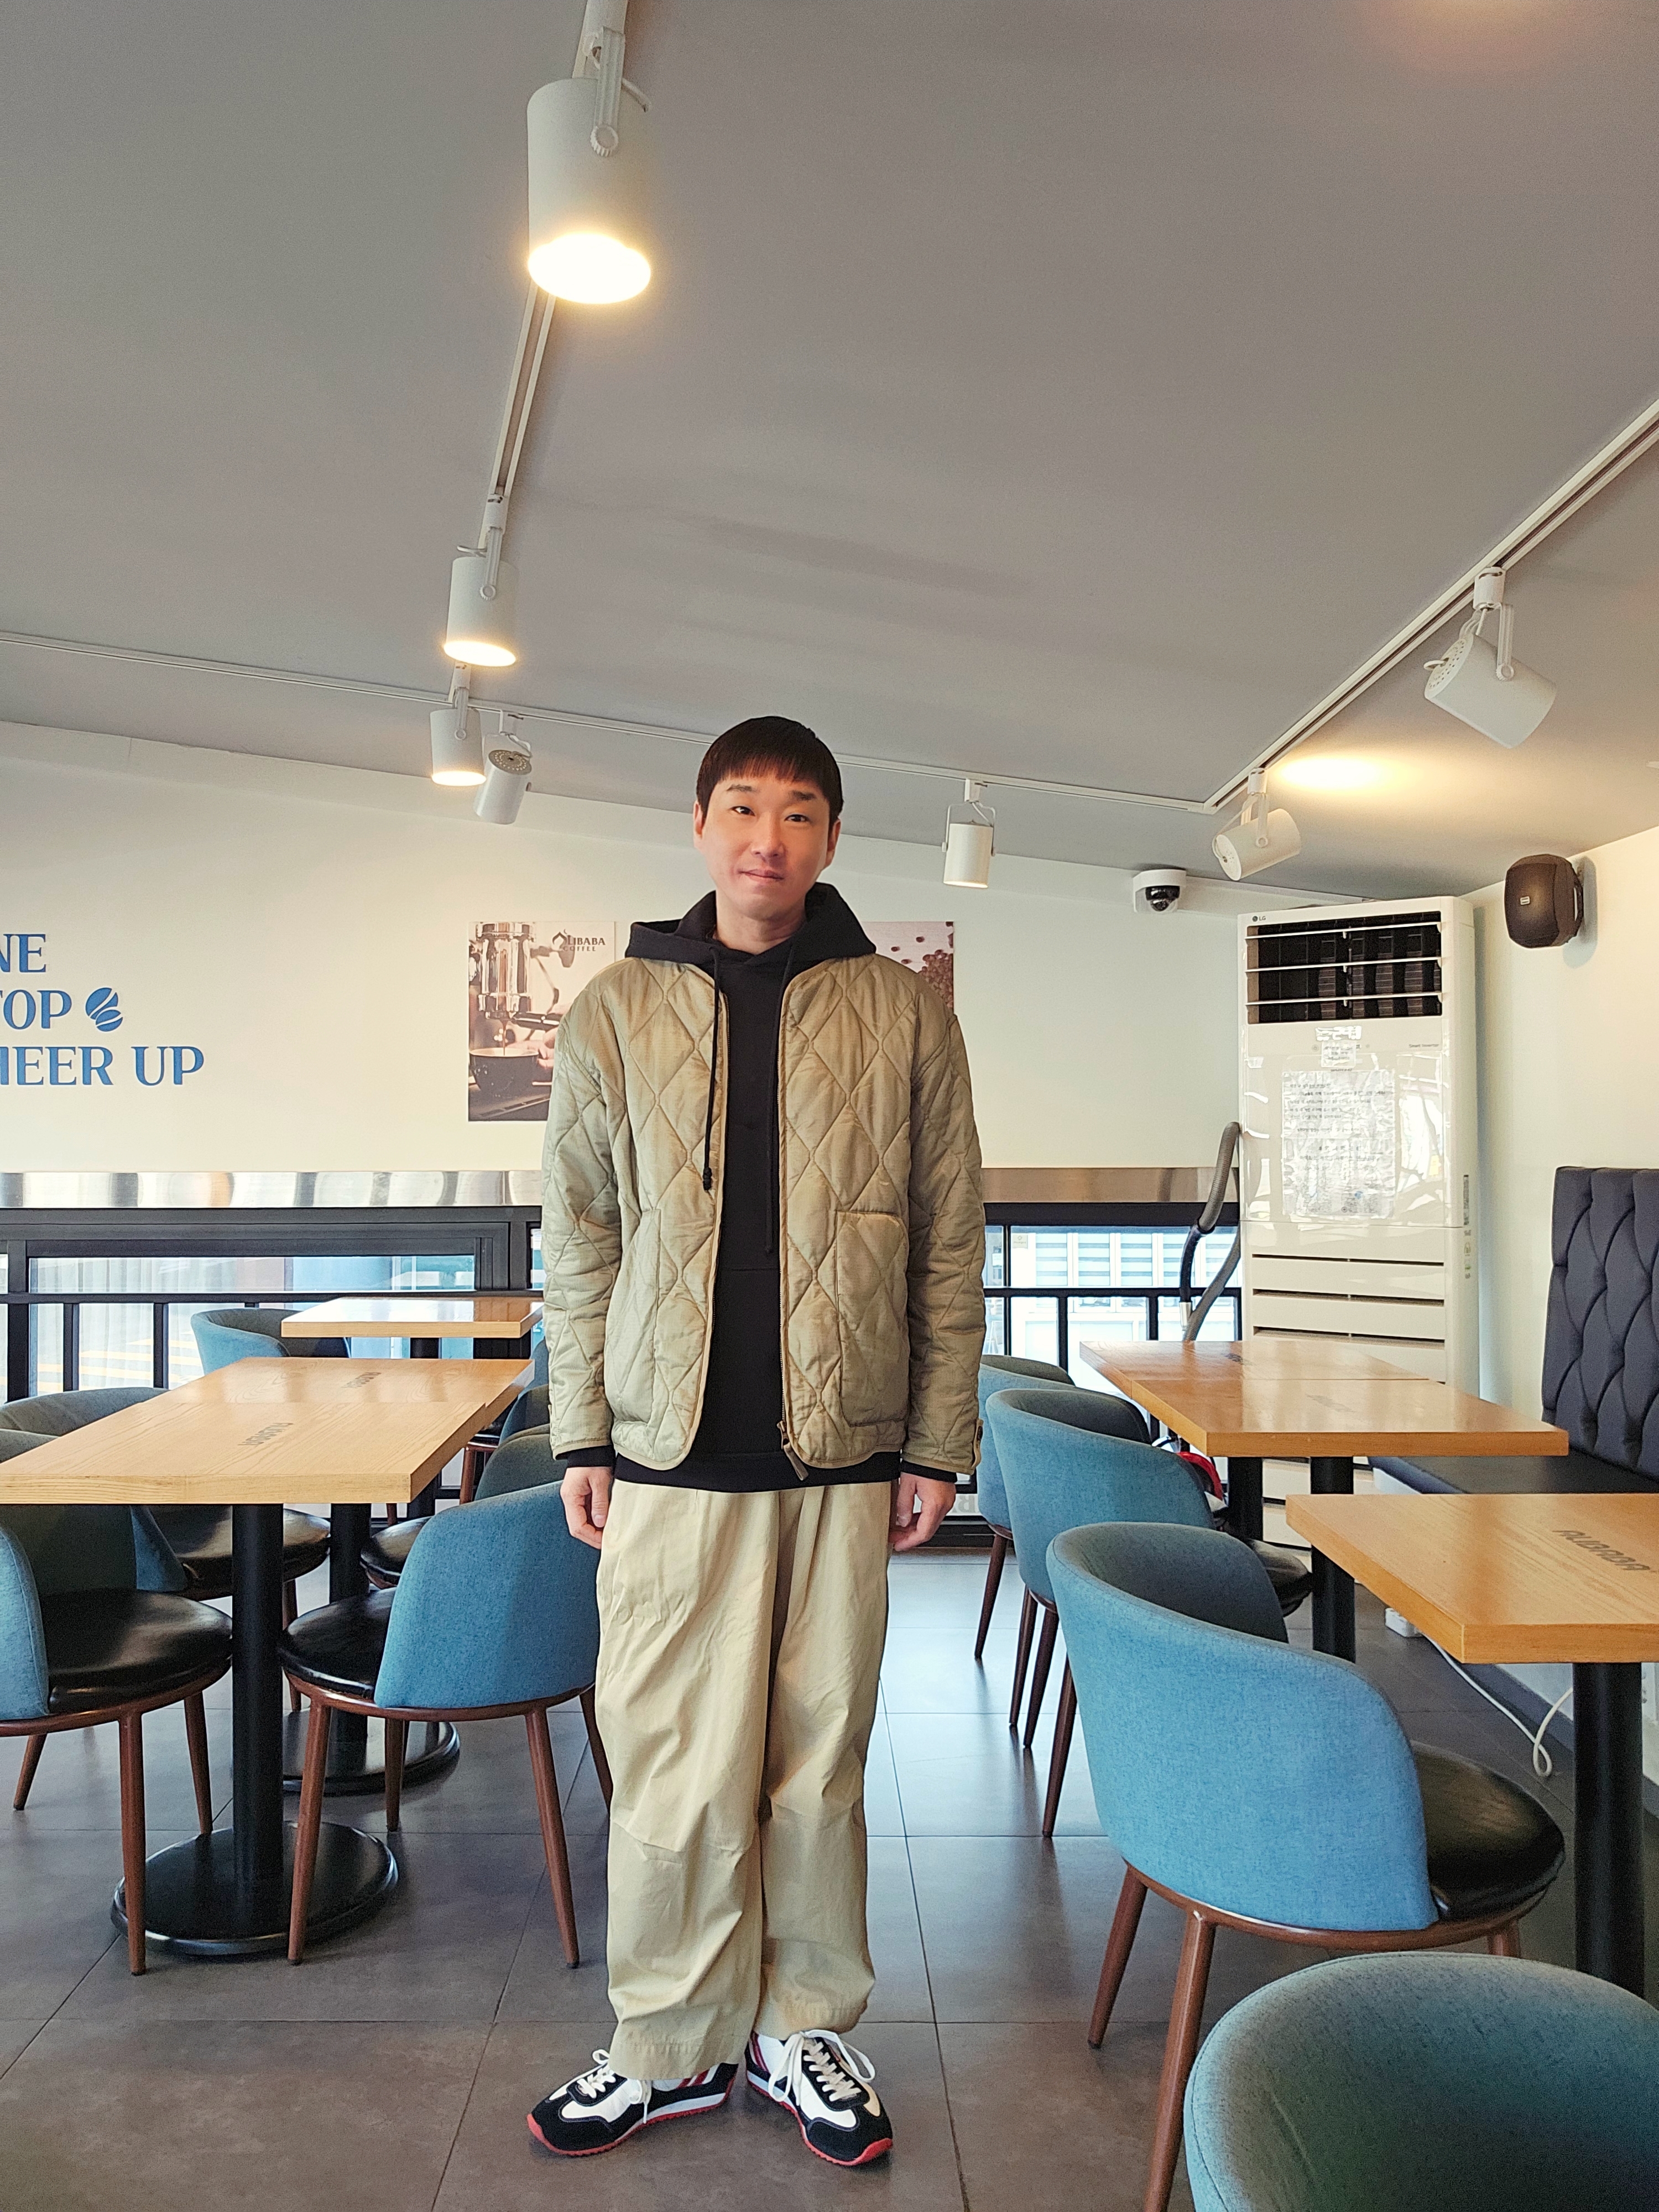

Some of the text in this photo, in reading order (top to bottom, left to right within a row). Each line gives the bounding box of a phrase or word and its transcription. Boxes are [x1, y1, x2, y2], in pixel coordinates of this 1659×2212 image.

[0, 989, 72, 1030] OP
[0, 1046, 204, 1086] EER UP
[1552, 1530, 1651, 1571] ALIBABA
